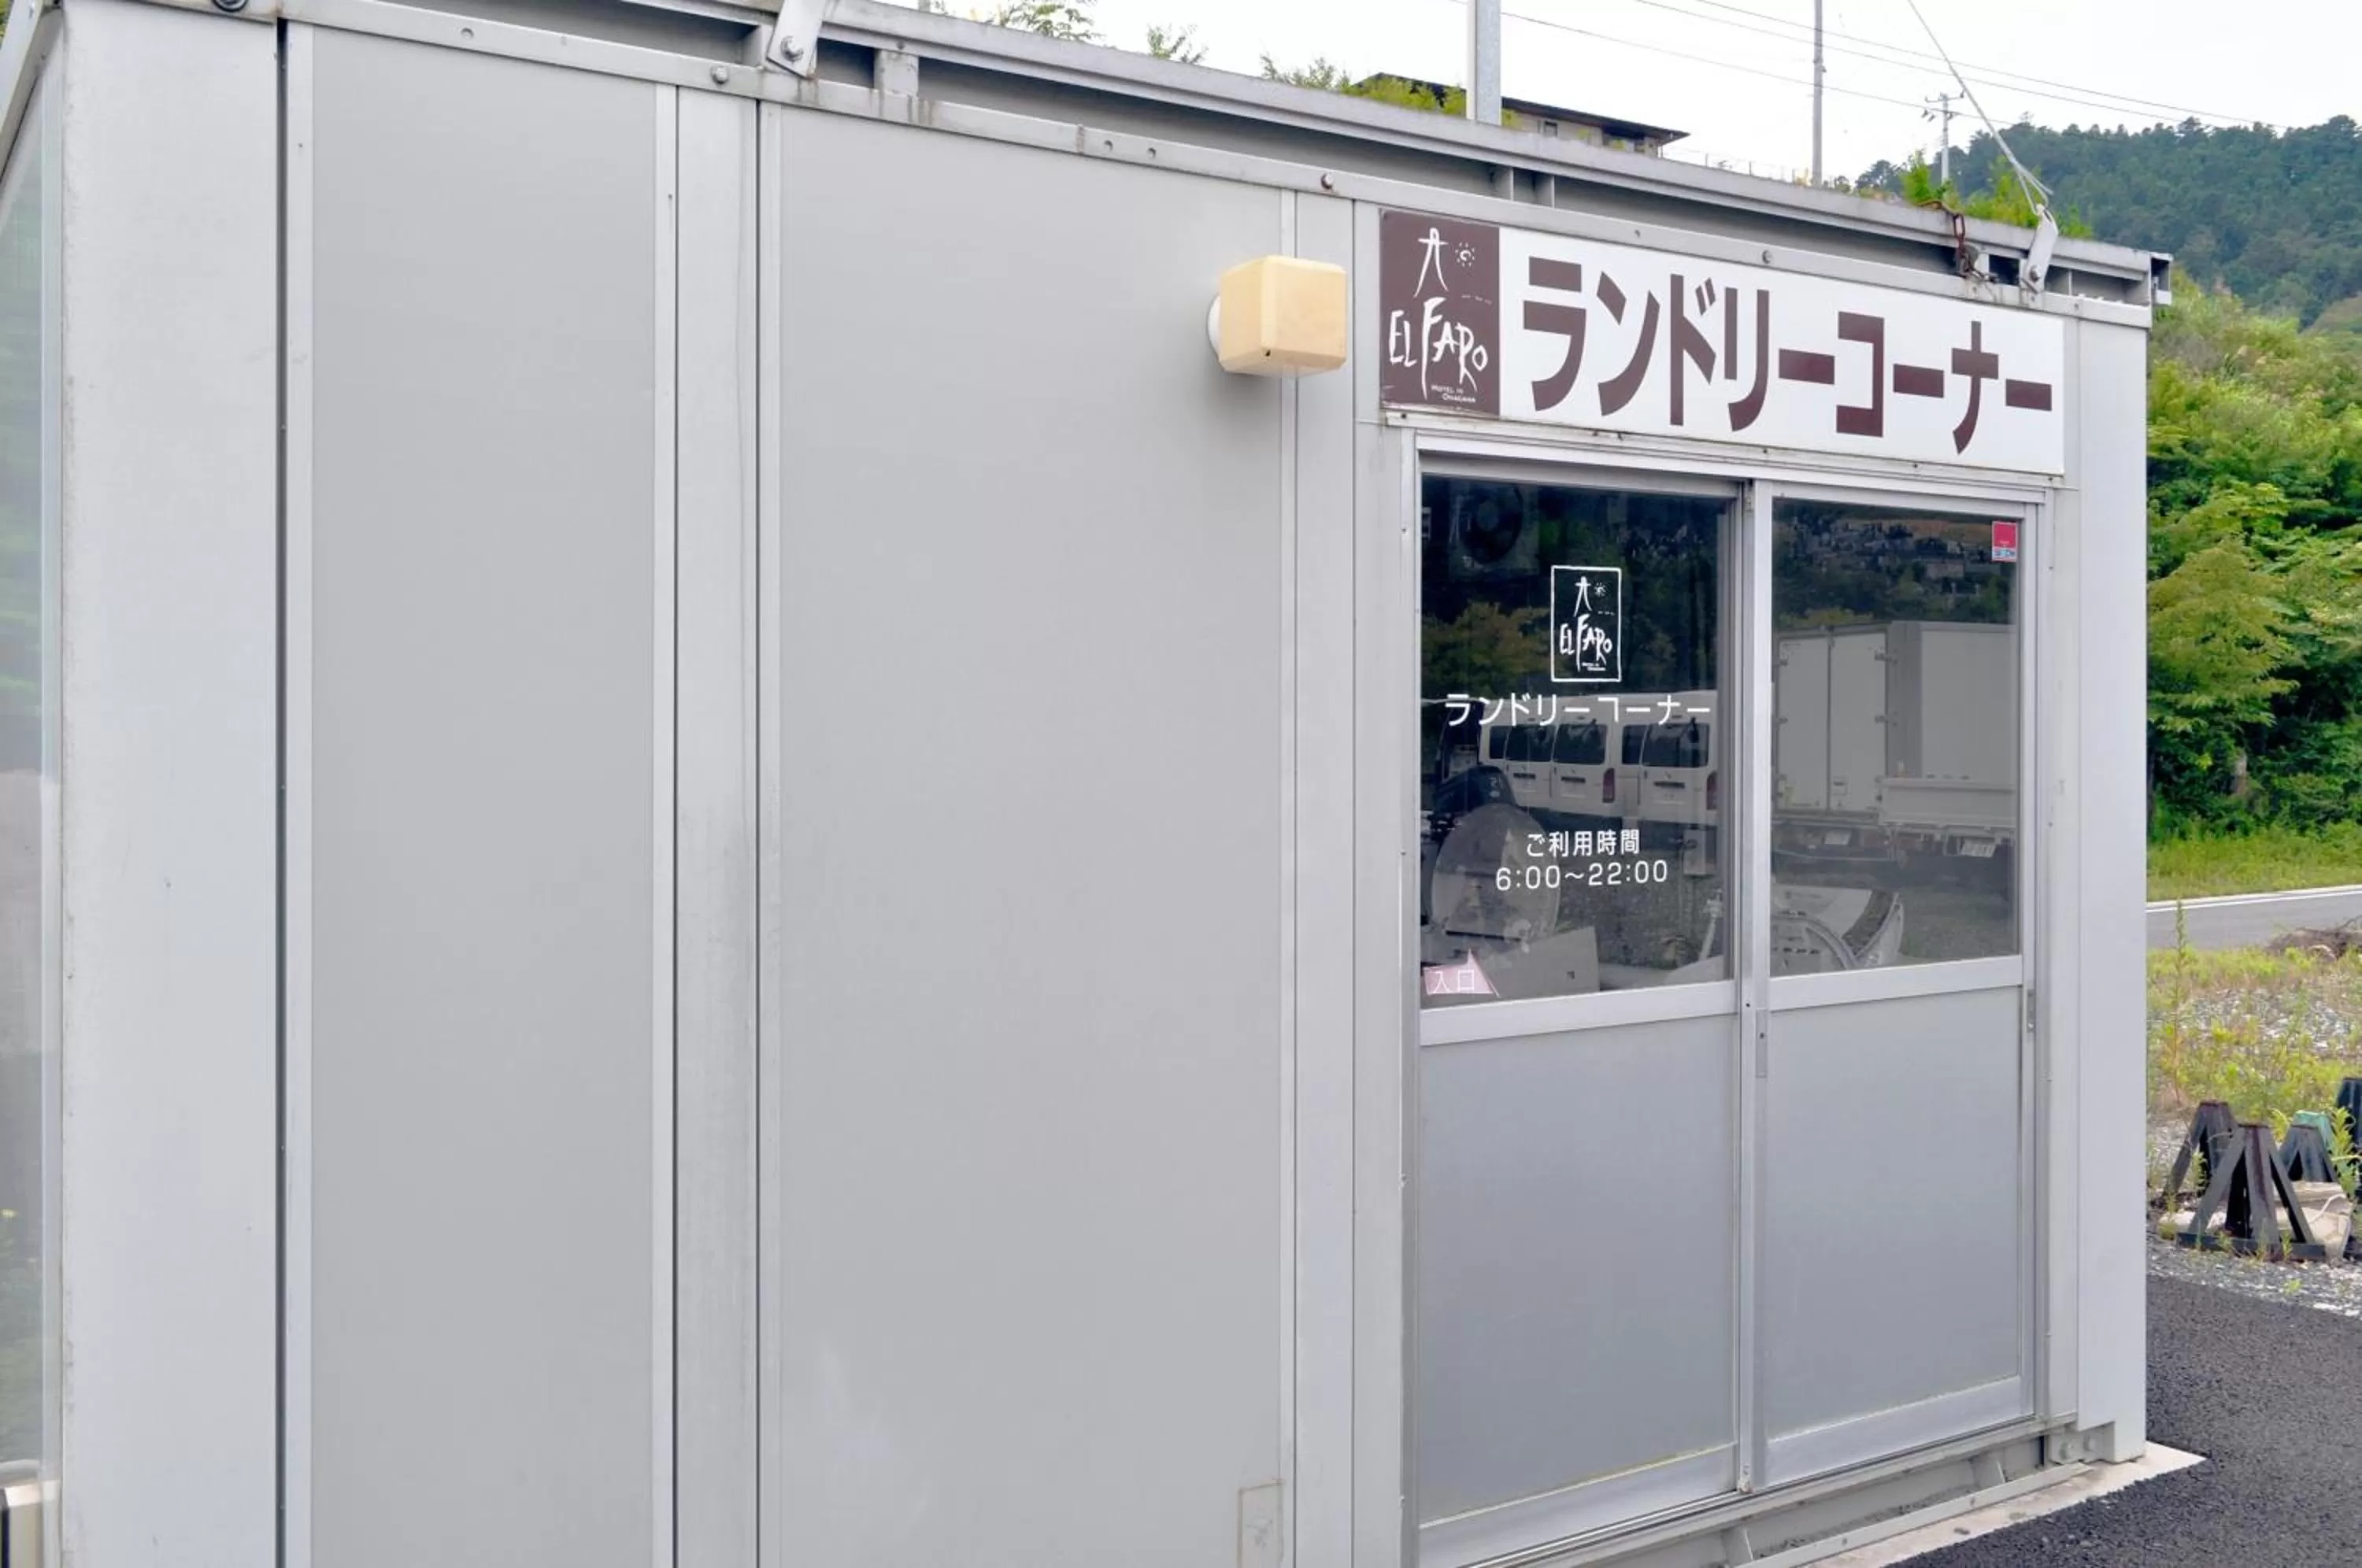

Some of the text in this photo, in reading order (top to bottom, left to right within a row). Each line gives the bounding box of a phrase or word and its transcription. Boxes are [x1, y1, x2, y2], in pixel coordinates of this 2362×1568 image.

[1388, 296, 1489, 401] EL FARO
[1523, 255, 2053, 455] ランドリーコーナー
[1559, 613, 1613, 673] EL FARO
[1526, 828, 1640, 858] ご利用時間
[1432, 969, 1475, 993] 入口
